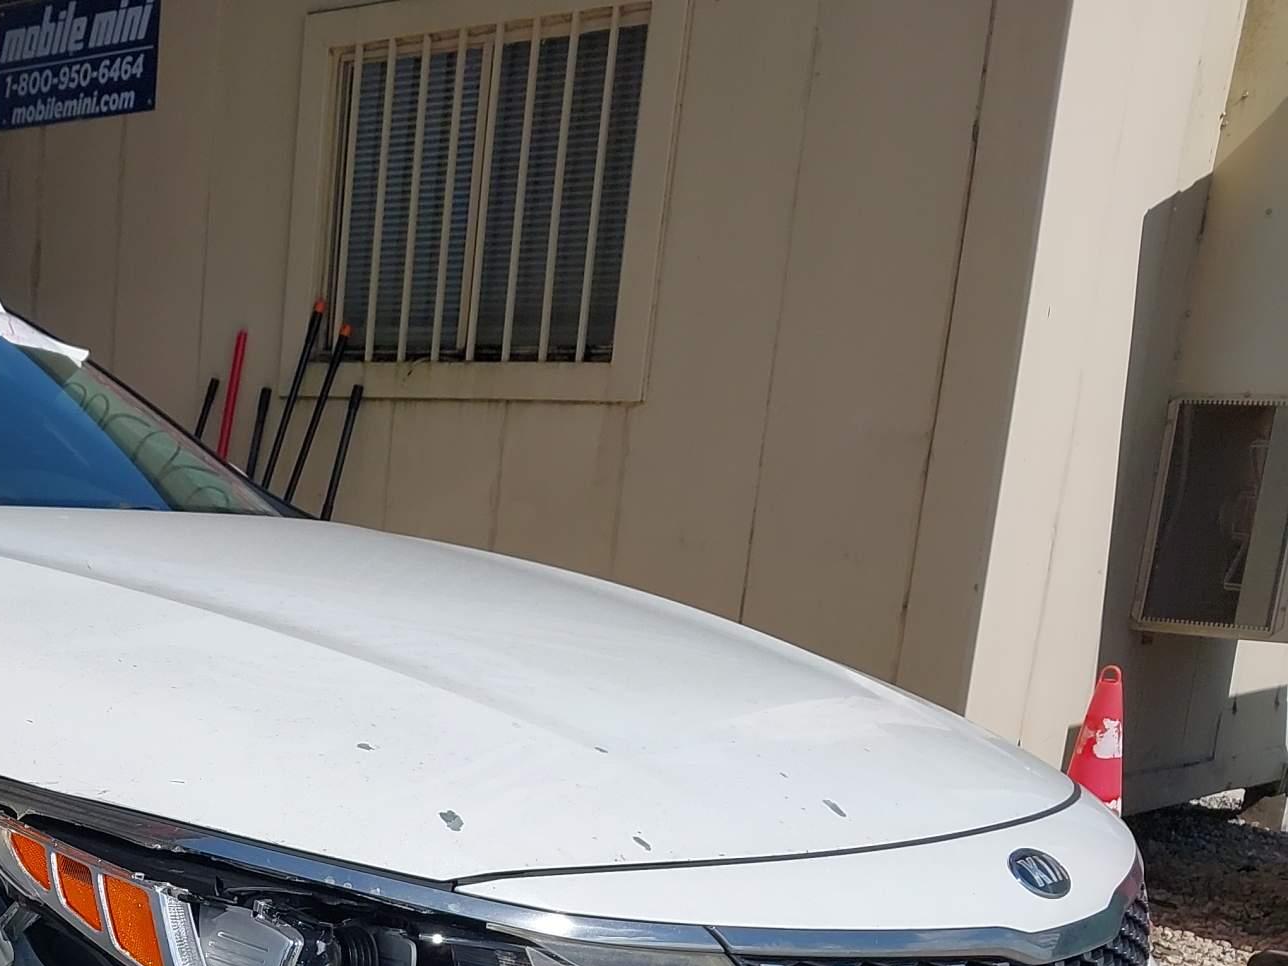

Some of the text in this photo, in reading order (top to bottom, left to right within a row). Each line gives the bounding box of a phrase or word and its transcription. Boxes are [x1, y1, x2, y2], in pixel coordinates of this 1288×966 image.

[0, 0, 154, 63] mobile mini
[5, 53, 145, 98] 1-800-950-6464
[12, 90, 135, 125] mobilemini.com
